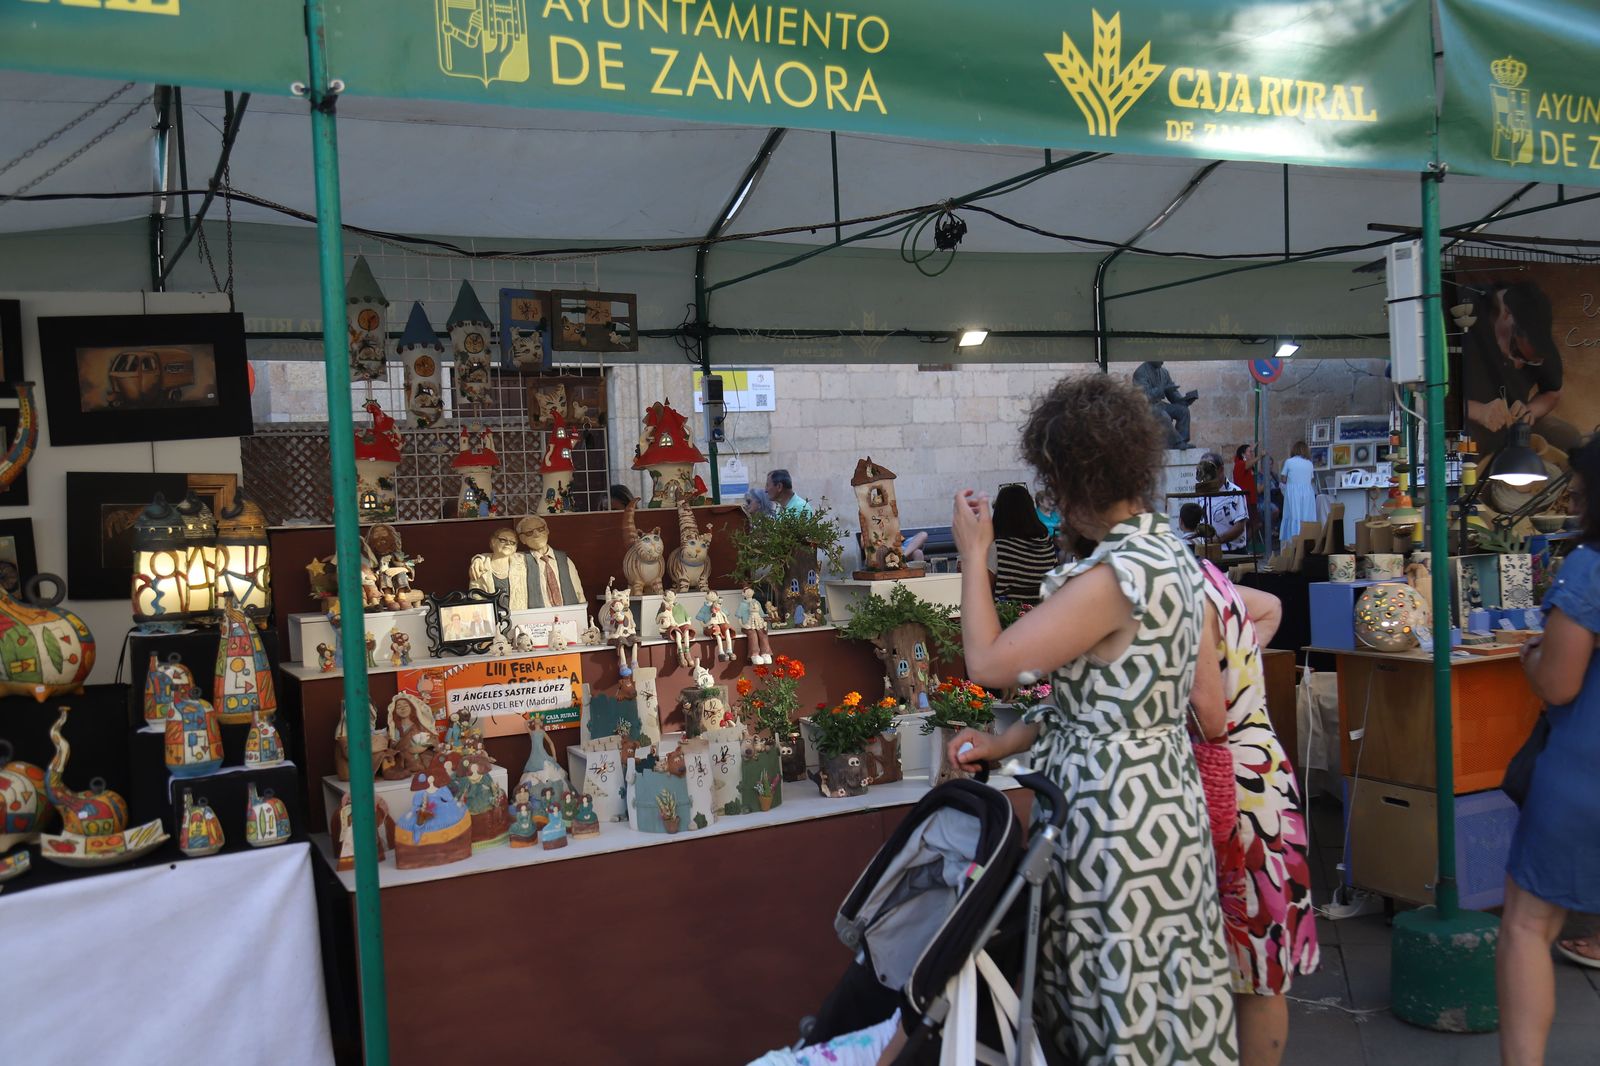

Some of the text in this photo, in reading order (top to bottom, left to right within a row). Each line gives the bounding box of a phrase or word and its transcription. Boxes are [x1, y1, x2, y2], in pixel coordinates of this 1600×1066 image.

[542, 0, 890, 53] AYUNTAMIENTO
[550, 35, 888, 115] DE ZAMORA
[1168, 67, 1378, 122] CAJA RURAL
[1166, 120, 1194, 142] DE
[1540, 130, 1578, 167] DE
[546, 666, 556, 674] DE
[557, 664, 568, 673] LA
[451, 683, 565, 702] 31 ÁNGELES SASTRE LÓPEZ
[493, 701, 507, 710] DEL
[510, 699, 525, 708] REY
[526, 696, 558, 708] (Madrid)
